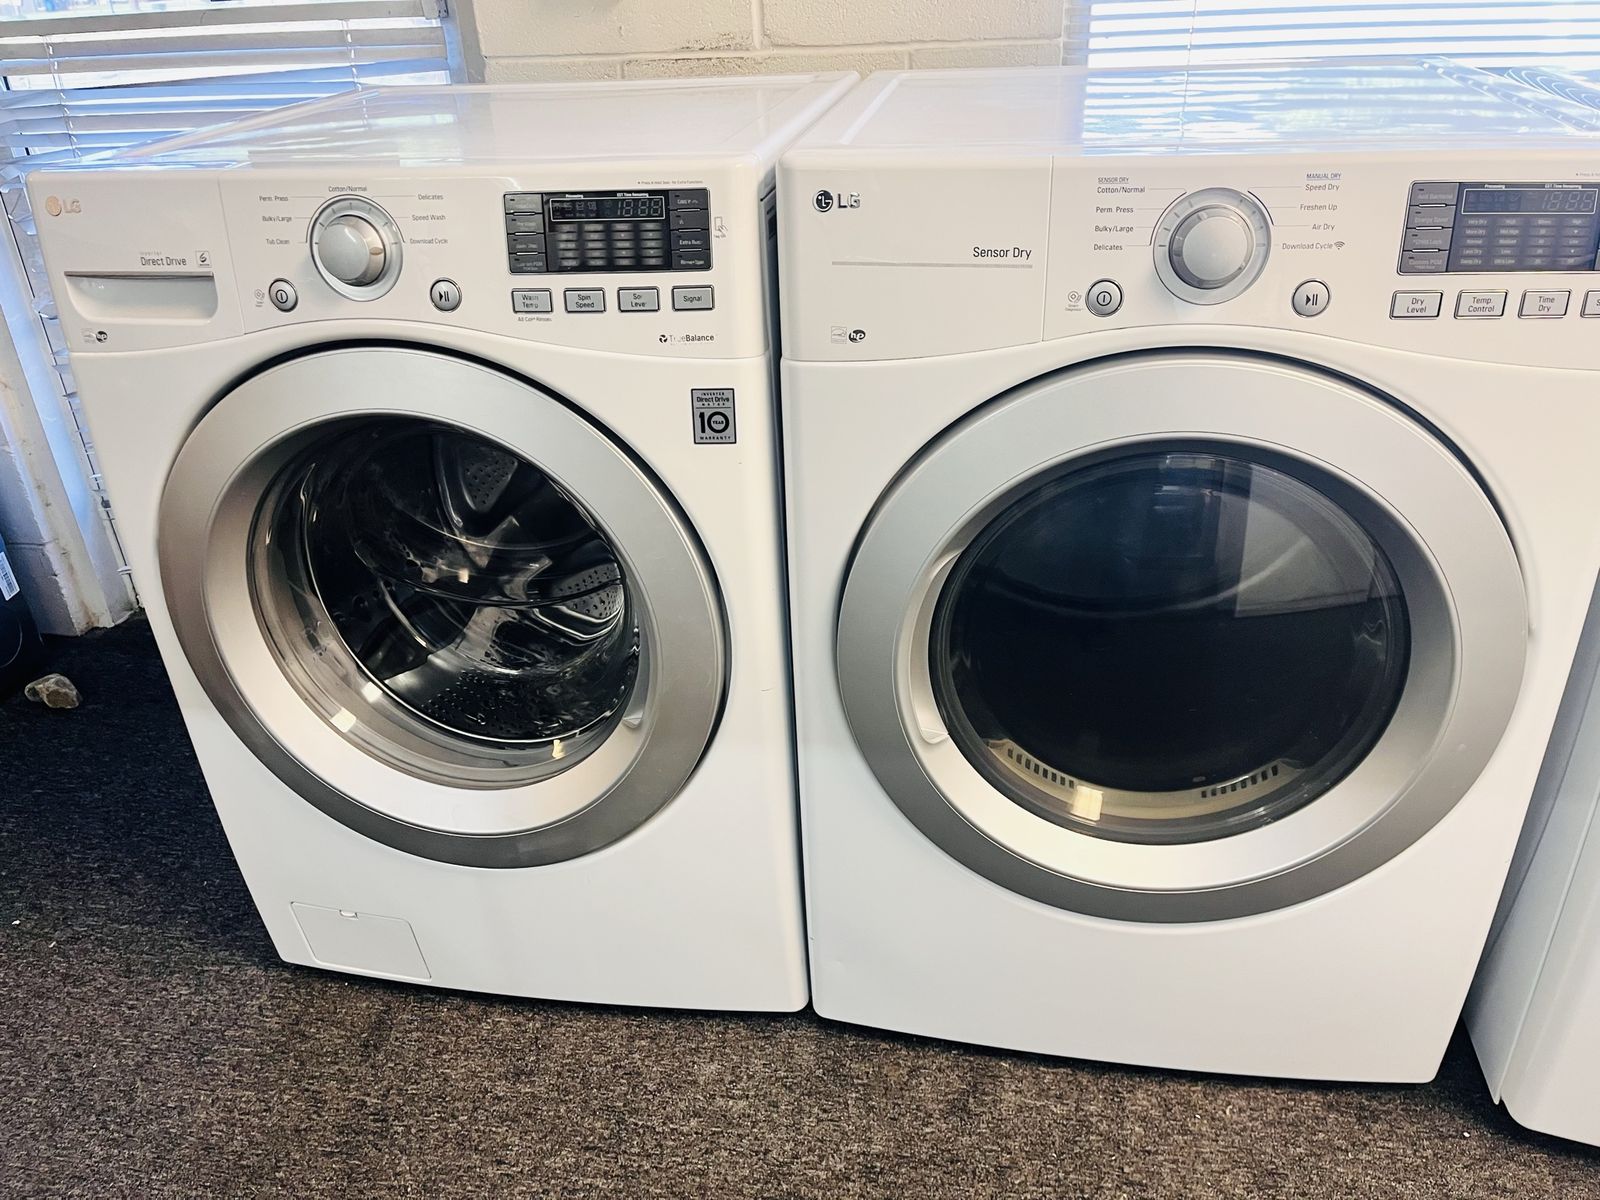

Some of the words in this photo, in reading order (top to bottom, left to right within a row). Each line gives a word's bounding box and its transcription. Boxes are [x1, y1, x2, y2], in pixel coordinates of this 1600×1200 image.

[1097, 186, 1146, 194] Cotton/Normal
[1305, 184, 1327, 192] Speed
[1328, 183, 1340, 191] Dry
[837, 191, 861, 209] LG
[62, 198, 82, 213] LG
[1300, 203, 1327, 211] Freshen
[1328, 203, 1338, 211] Up
[1094, 225, 1135, 233] Bulky/Large
[1323, 223, 1335, 231] Dry
[1282, 242, 1314, 250] Download
[1315, 242, 1333, 250] Cycle
[972, 246, 1010, 258] Sensor
[1012, 246, 1032, 260] Dry
[140, 256, 164, 266] Direct
[165, 256, 187, 266] Drive
[683, 295, 703, 303] Signal
[1411, 298, 1424, 306] Dry
[1538, 296, 1555, 304] Time
[1467, 305, 1495, 313] Control
[669, 334, 715, 342] TeBalance
[698, 411, 730, 434] 10
